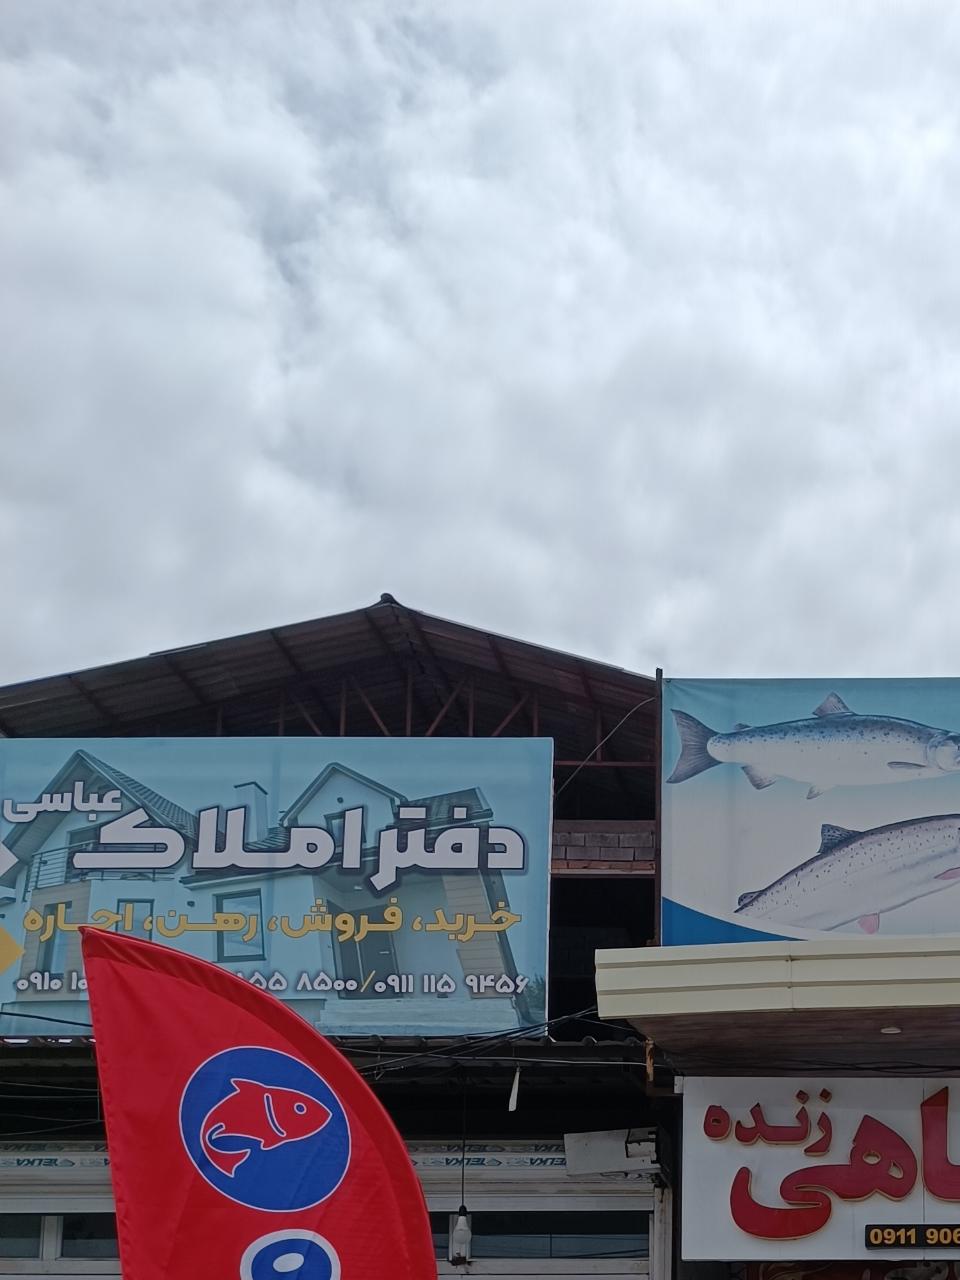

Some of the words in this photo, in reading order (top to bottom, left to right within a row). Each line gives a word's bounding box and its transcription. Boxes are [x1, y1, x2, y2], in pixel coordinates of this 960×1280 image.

[2, 781, 123, 823] عباسی
[73, 804, 365, 870] املاک
[369, 806, 525, 892] دفتر
[423, 973, 456, 992] ۱۱۵
[465, 973, 530, 994] ۹۴۵۶
[703, 1088, 833, 1156] زنده
[869, 1228, 917, 1246] 0911
